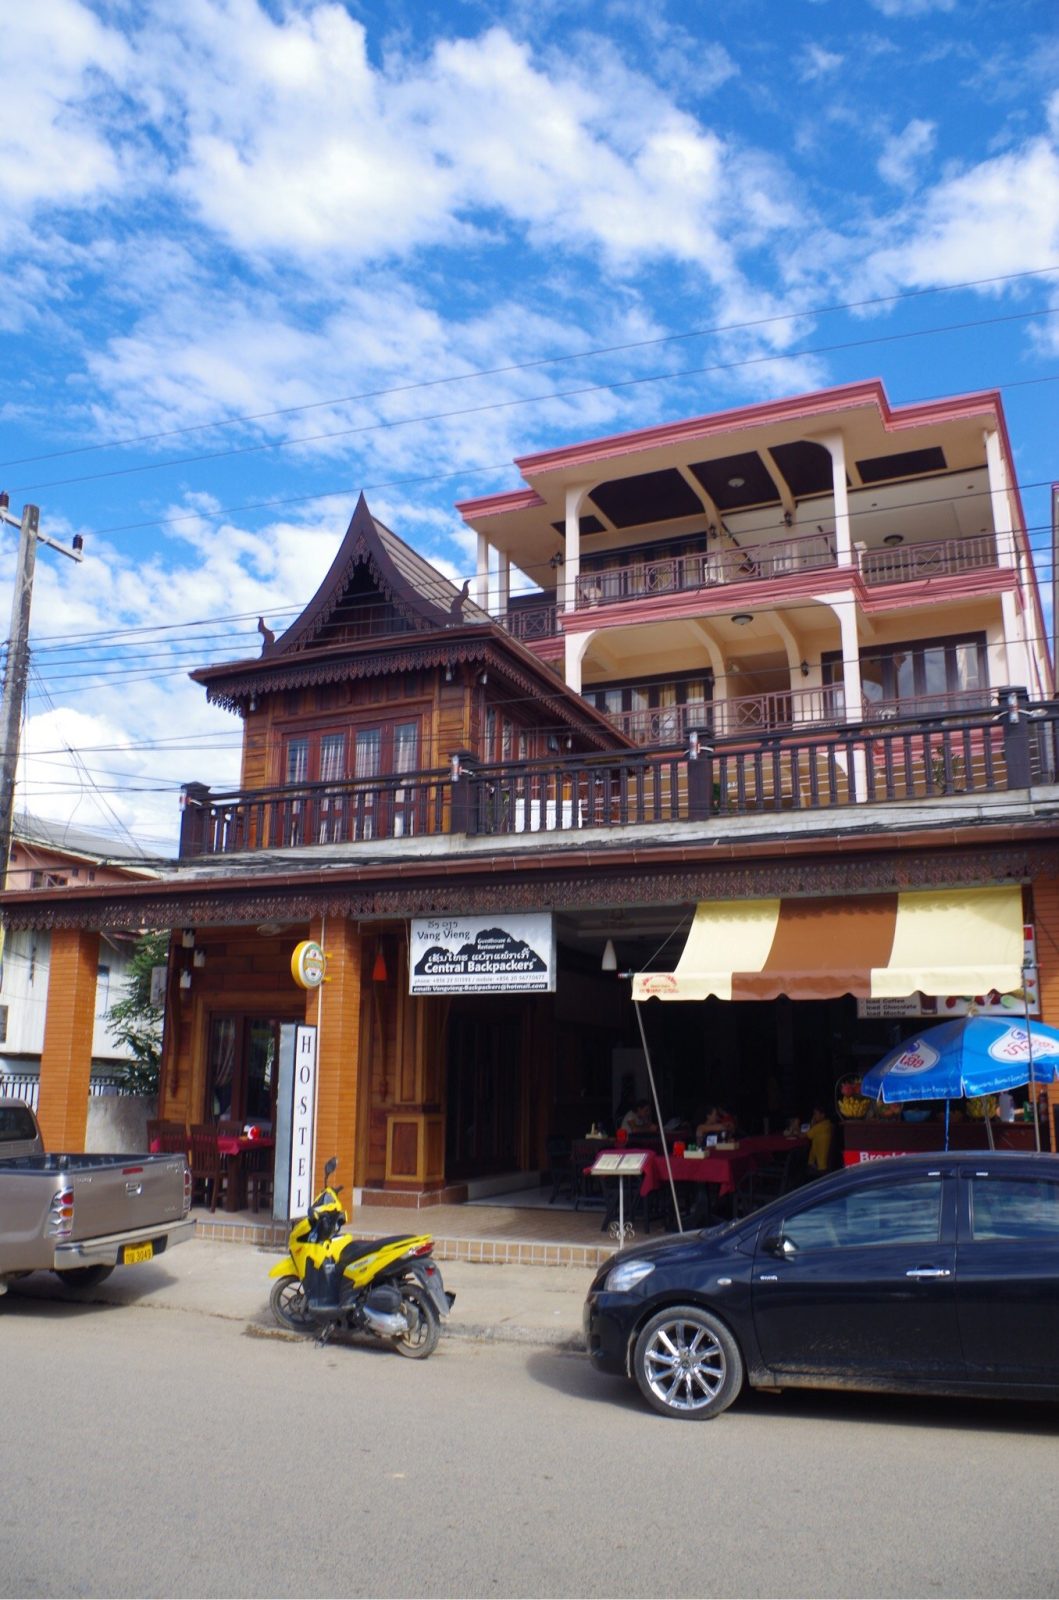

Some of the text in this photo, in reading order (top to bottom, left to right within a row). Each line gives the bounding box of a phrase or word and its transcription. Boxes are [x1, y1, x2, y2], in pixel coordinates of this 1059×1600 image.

[417, 930, 470, 941] Vang Vieng
[424, 959, 534, 974] Central Backpackers
[297, 1035, 311, 1208] HOSTEL
